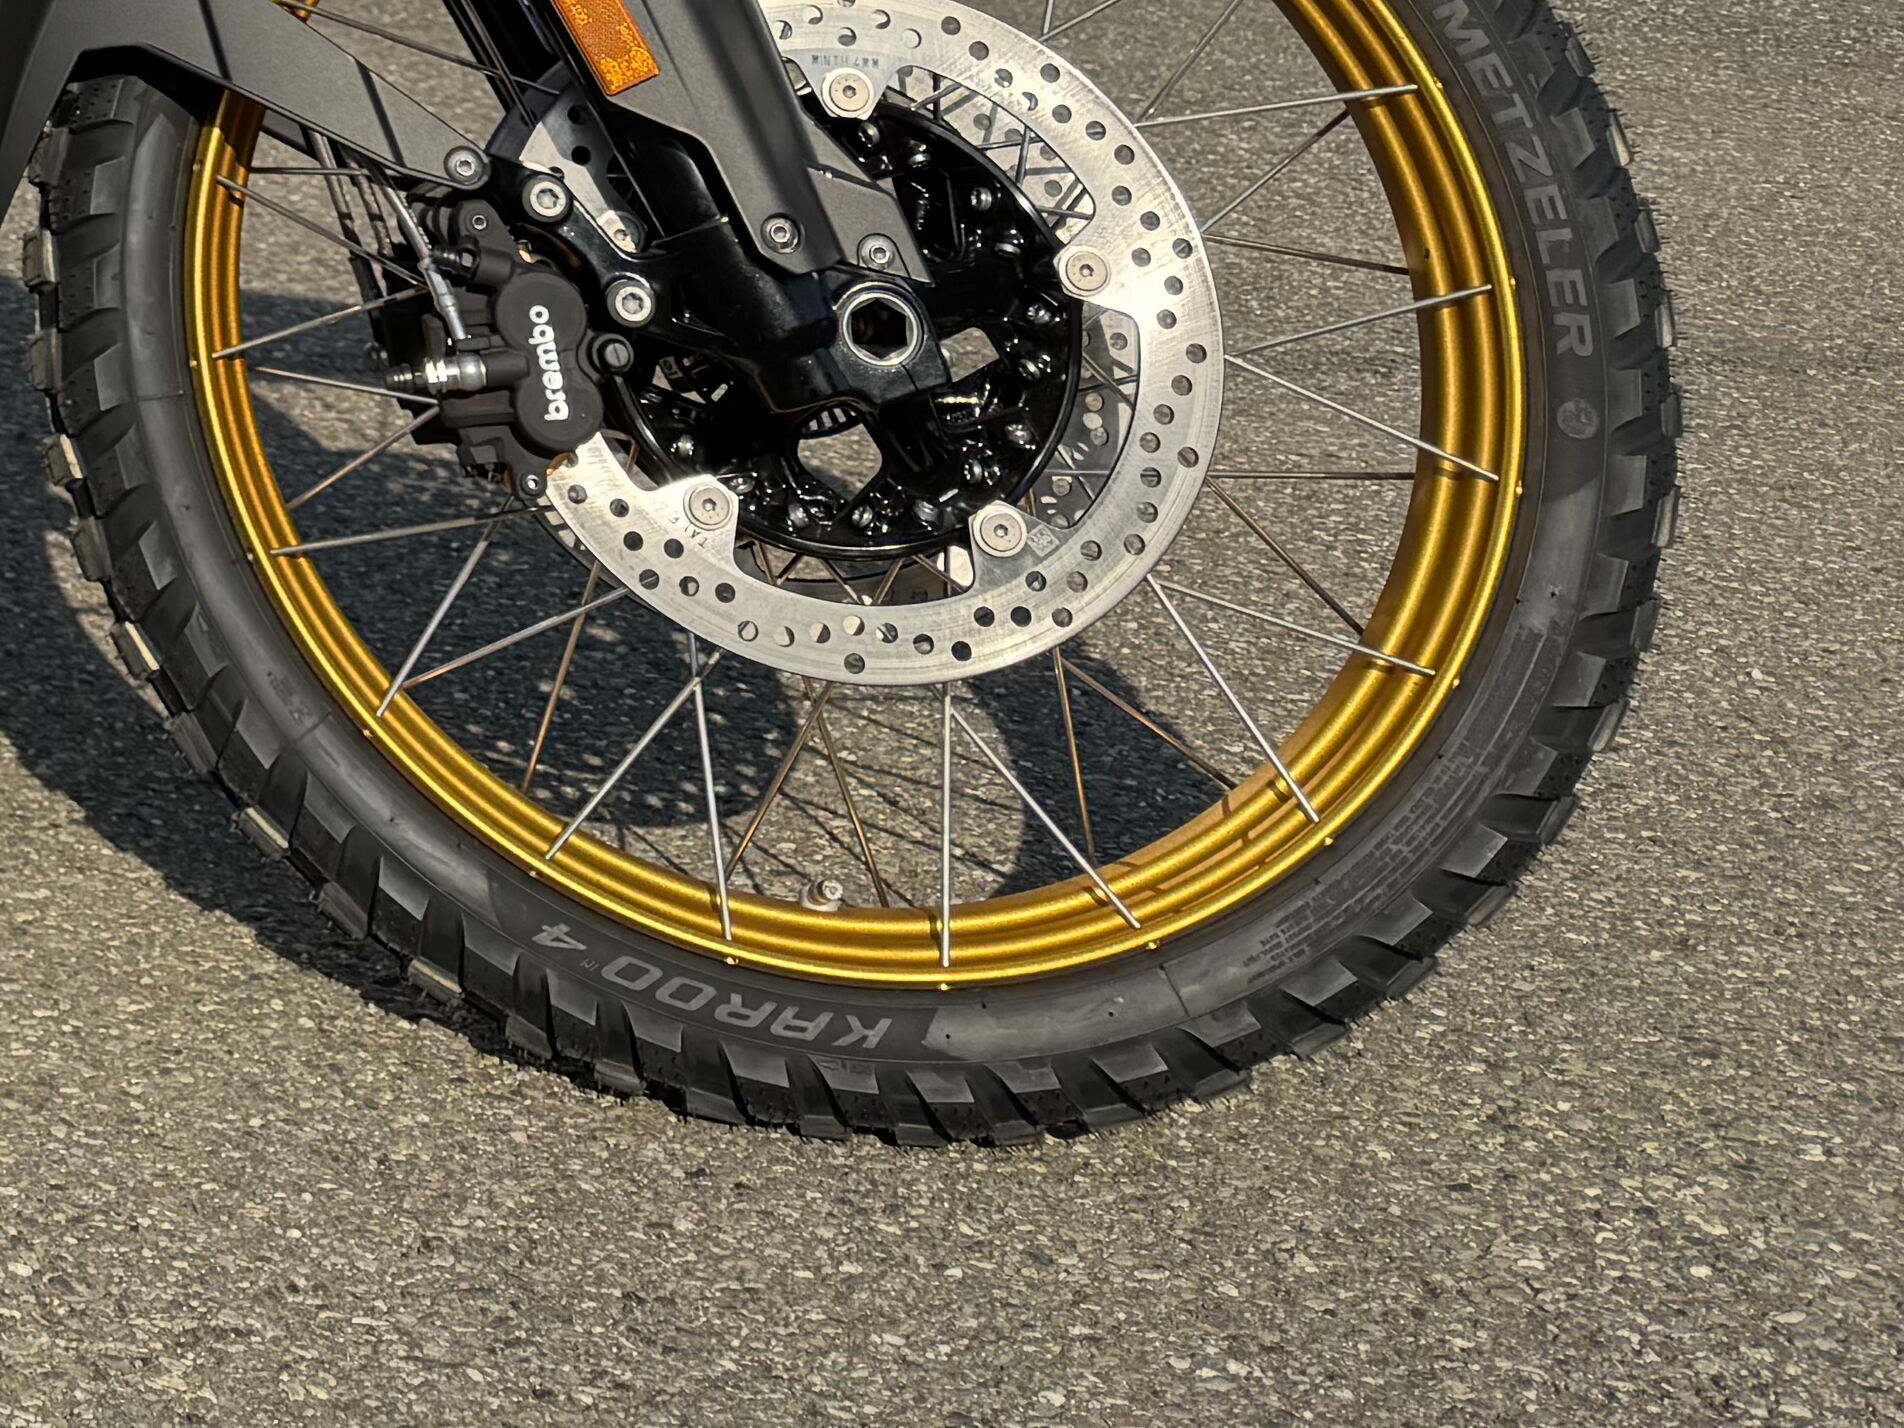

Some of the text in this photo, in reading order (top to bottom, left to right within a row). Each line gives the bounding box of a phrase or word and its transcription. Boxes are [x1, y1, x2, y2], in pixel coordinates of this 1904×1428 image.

[528, 303, 570, 422] brembo
[530, 921, 892, 1050] KAROO 4
